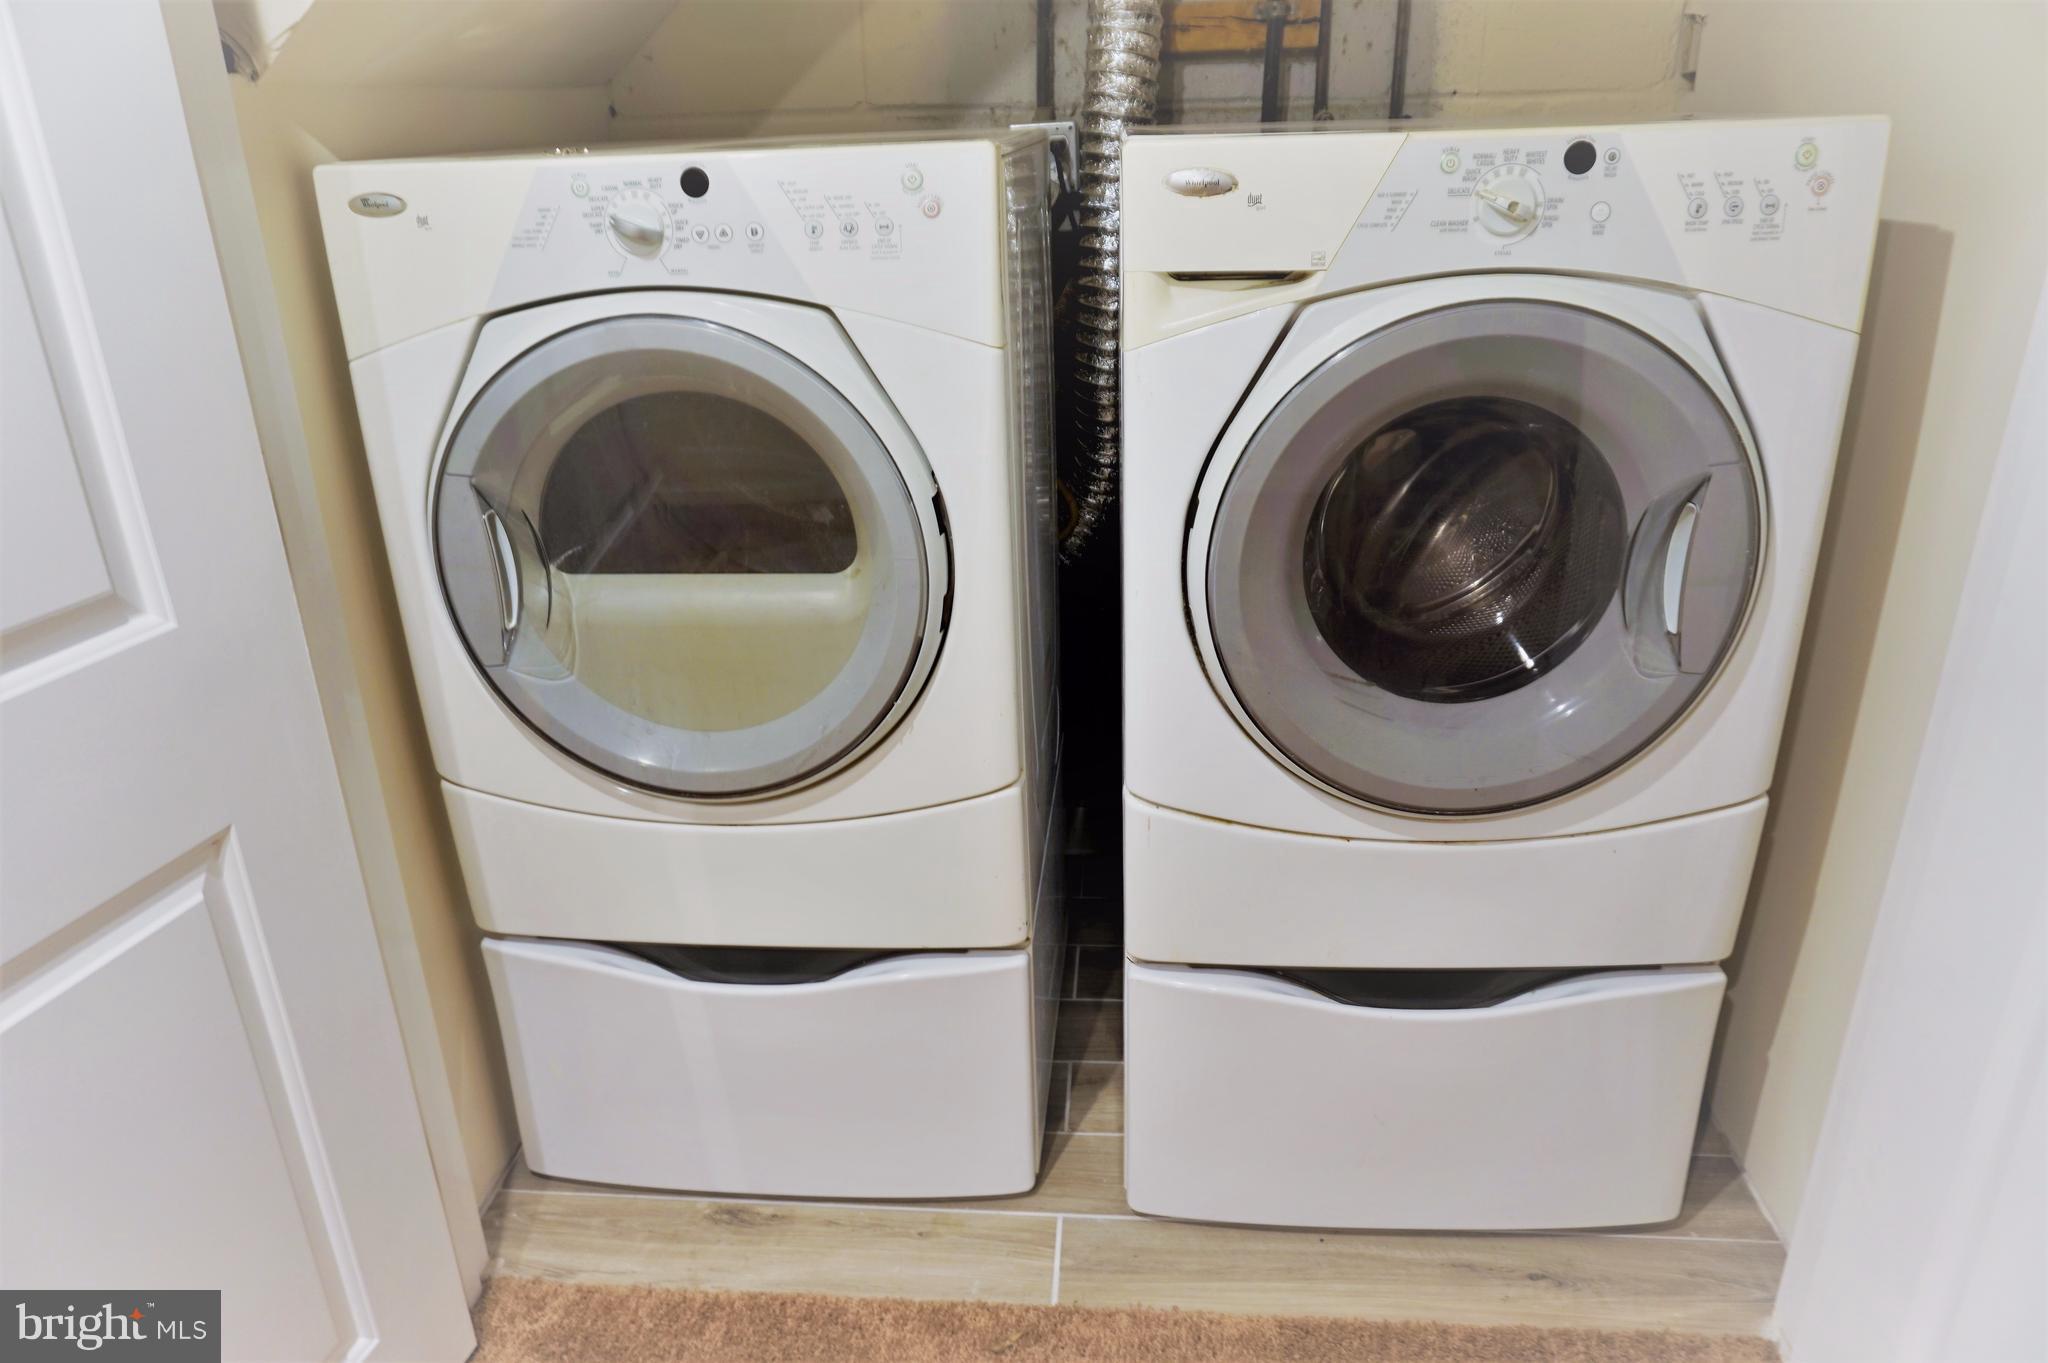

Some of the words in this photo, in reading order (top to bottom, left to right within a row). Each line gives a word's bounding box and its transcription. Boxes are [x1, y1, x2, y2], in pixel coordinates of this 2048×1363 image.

[1185, 178, 1220, 189] Whirlpool
[1447, 187, 1470, 195] DELICATE
[360, 198, 389, 209] Whirlpool
